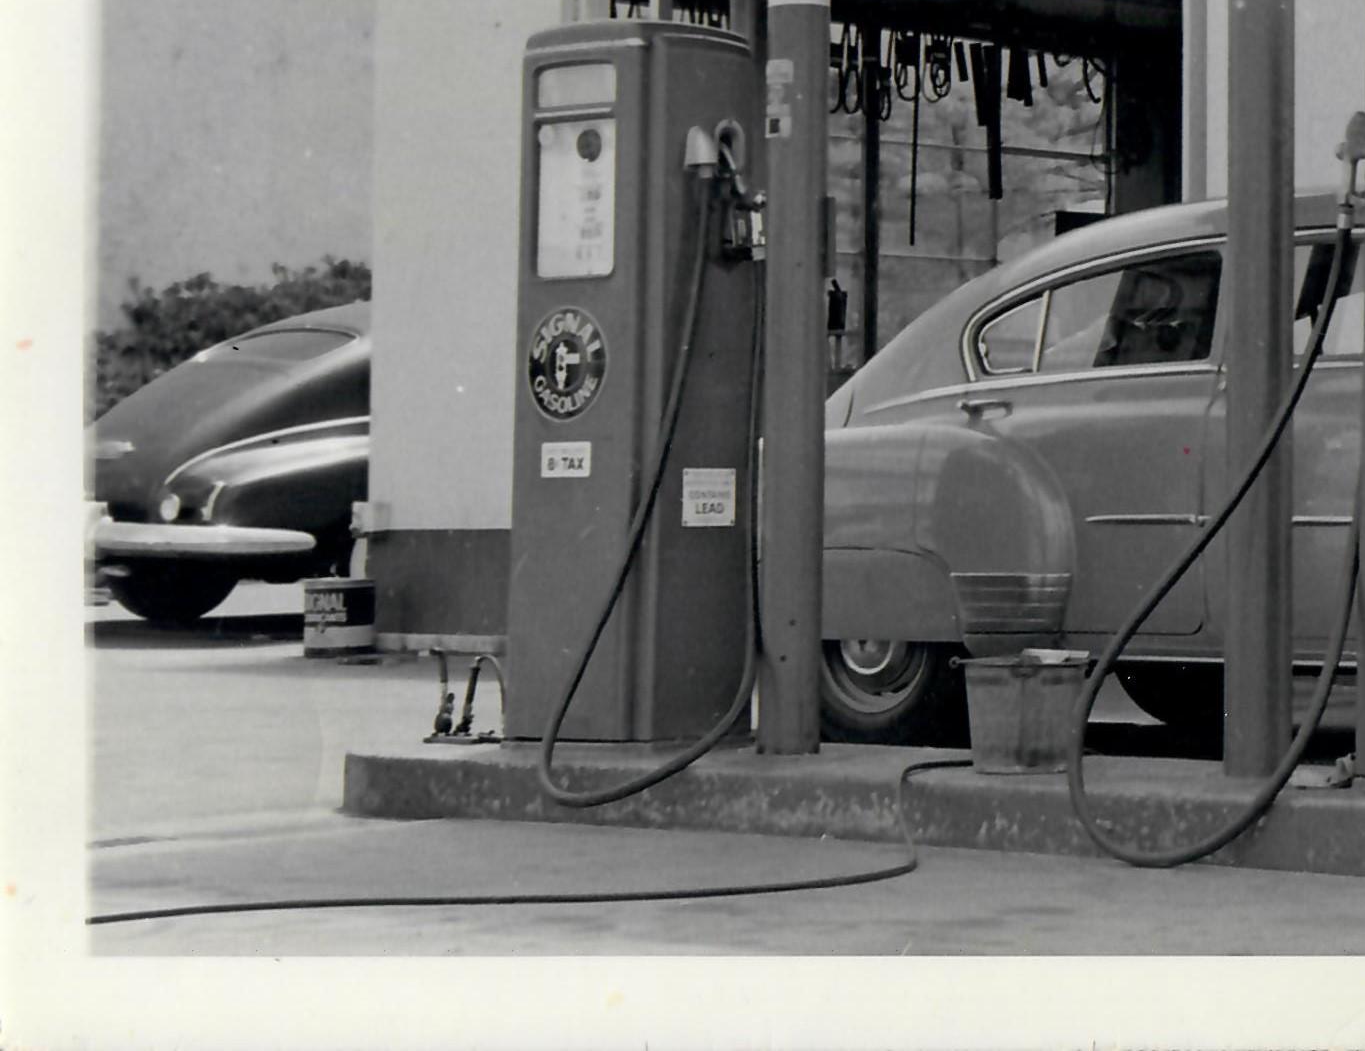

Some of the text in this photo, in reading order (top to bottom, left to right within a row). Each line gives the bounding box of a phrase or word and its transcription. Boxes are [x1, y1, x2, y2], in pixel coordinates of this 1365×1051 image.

[533, 312, 602, 364] SIGNAL
[534, 373, 599, 414] GASOLINE
[561, 457, 585, 471] TAX
[695, 502, 725, 515] LEAD
